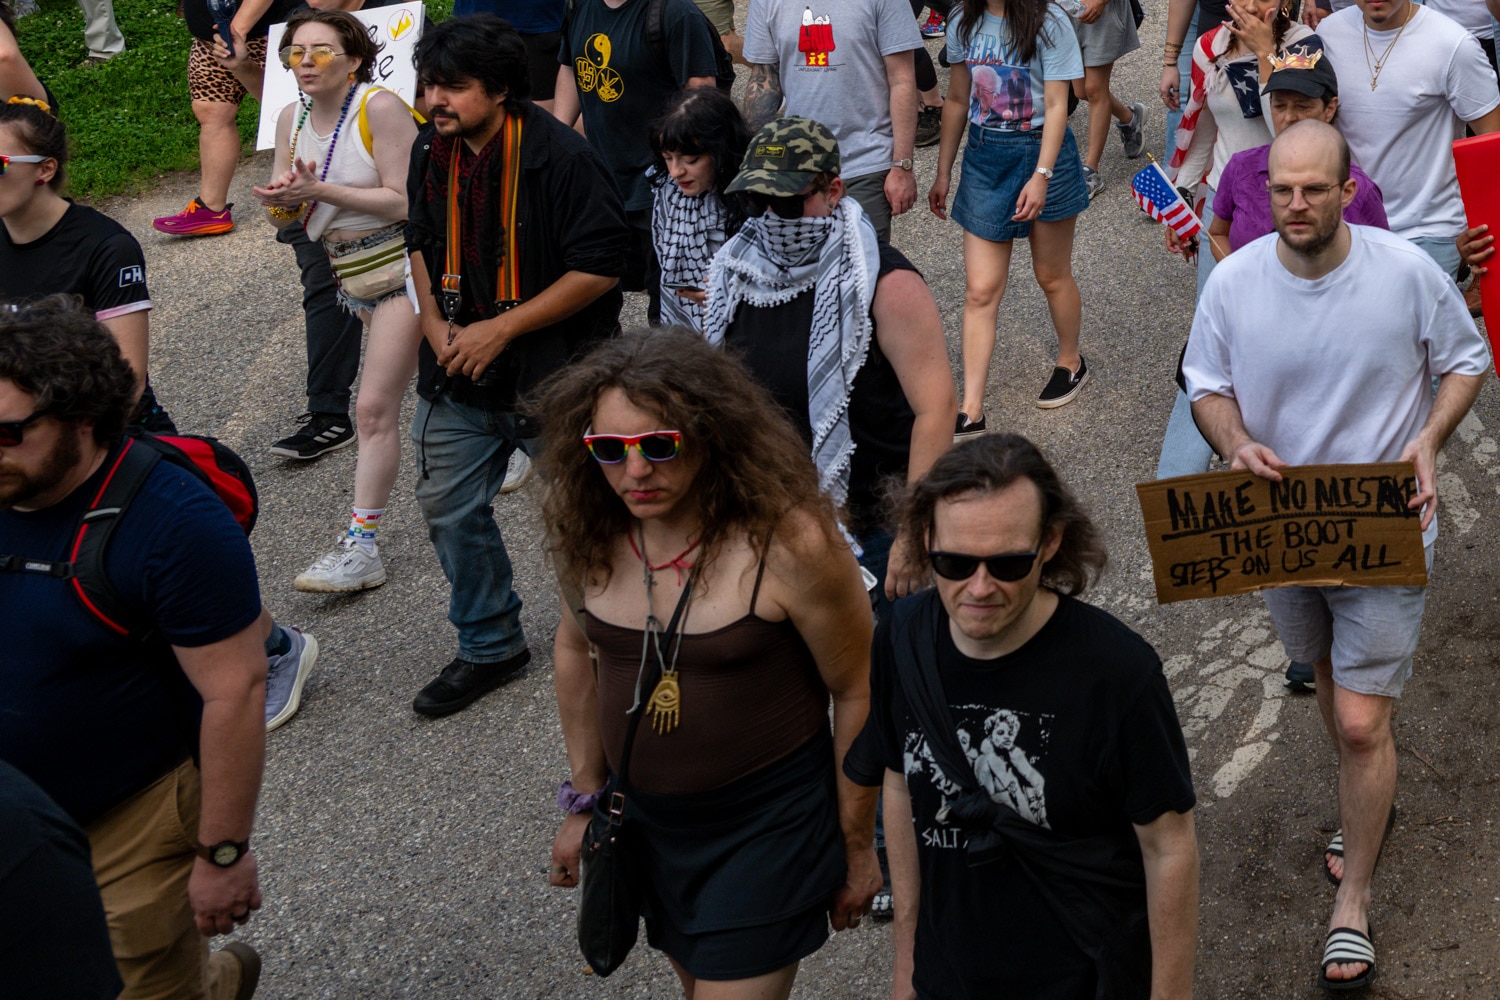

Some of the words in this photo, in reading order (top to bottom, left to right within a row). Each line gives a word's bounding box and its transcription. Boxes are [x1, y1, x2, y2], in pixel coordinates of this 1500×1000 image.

[808, 51, 827, 66] it
[1167, 481, 1253, 531] MAKE
[1270, 478, 1307, 513] NO
[1211, 526, 1274, 555] THE
[1284, 519, 1357, 549] BOOT
[1170, 556, 1238, 593] STEPS
[1241, 555, 1270, 575] ON
[1282, 550, 1318, 573] US
[1332, 544, 1401, 571] ALL
[922, 827, 961, 849] SALT
